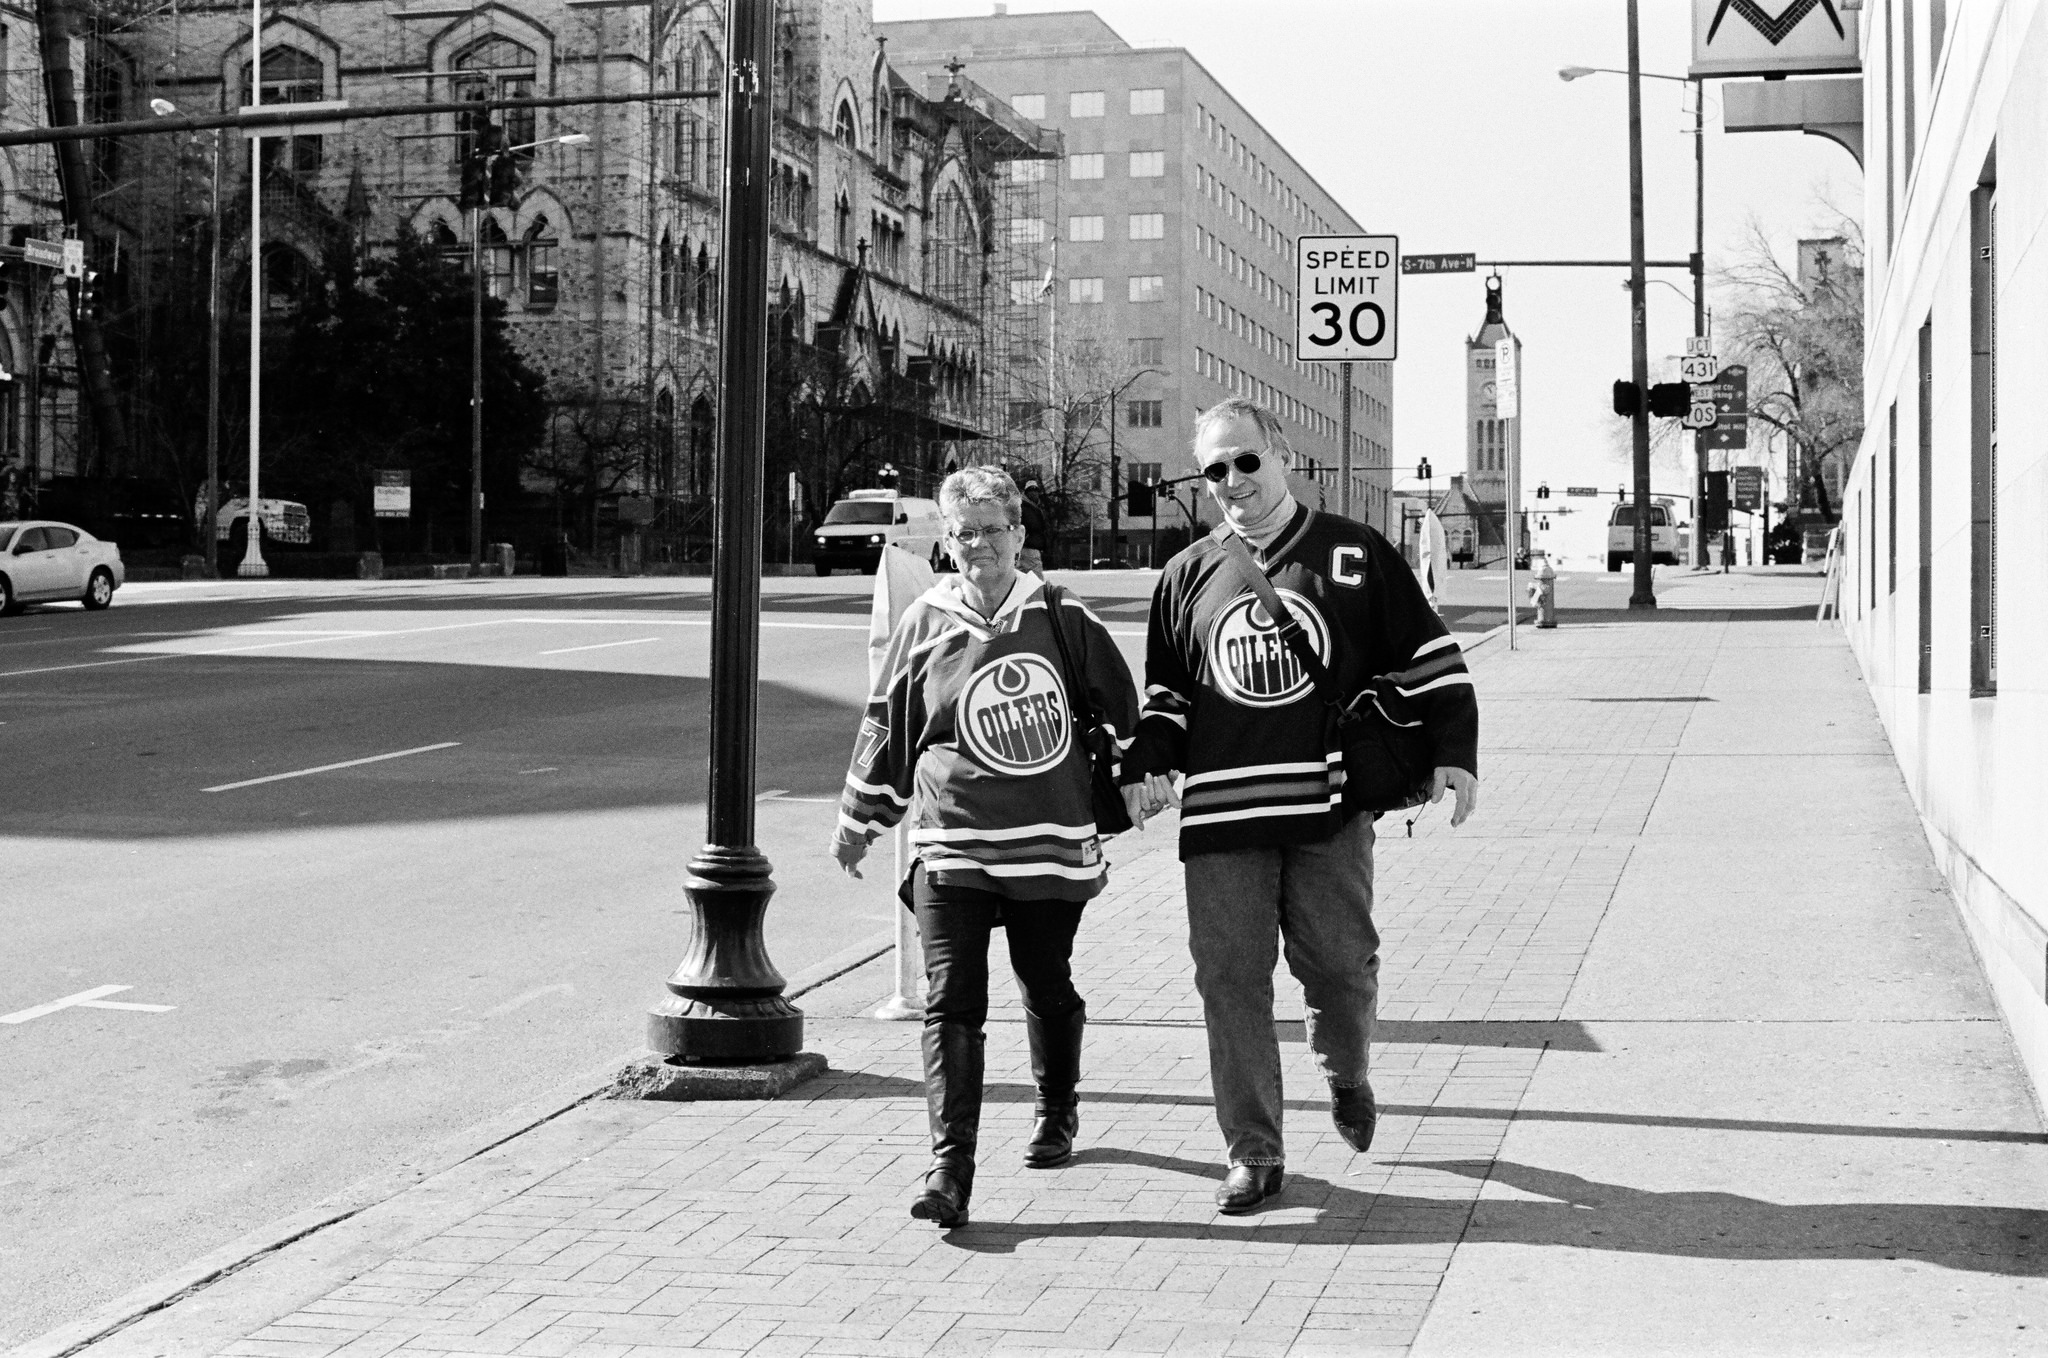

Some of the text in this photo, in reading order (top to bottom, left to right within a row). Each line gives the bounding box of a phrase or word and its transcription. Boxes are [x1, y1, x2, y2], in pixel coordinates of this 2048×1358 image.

[27, 244, 61, 264] Broadway
[1306, 250, 1390, 269] SPEED
[1315, 276, 1380, 295] LIMIT
[1308, 301, 1386, 347] 30
[1687, 340, 1709, 352] JCT
[1684, 362, 1714, 377] 431
[1329, 544, 1366, 588] C
[976, 691, 1062, 750] OILERS
[858, 717, 890, 768] 7
